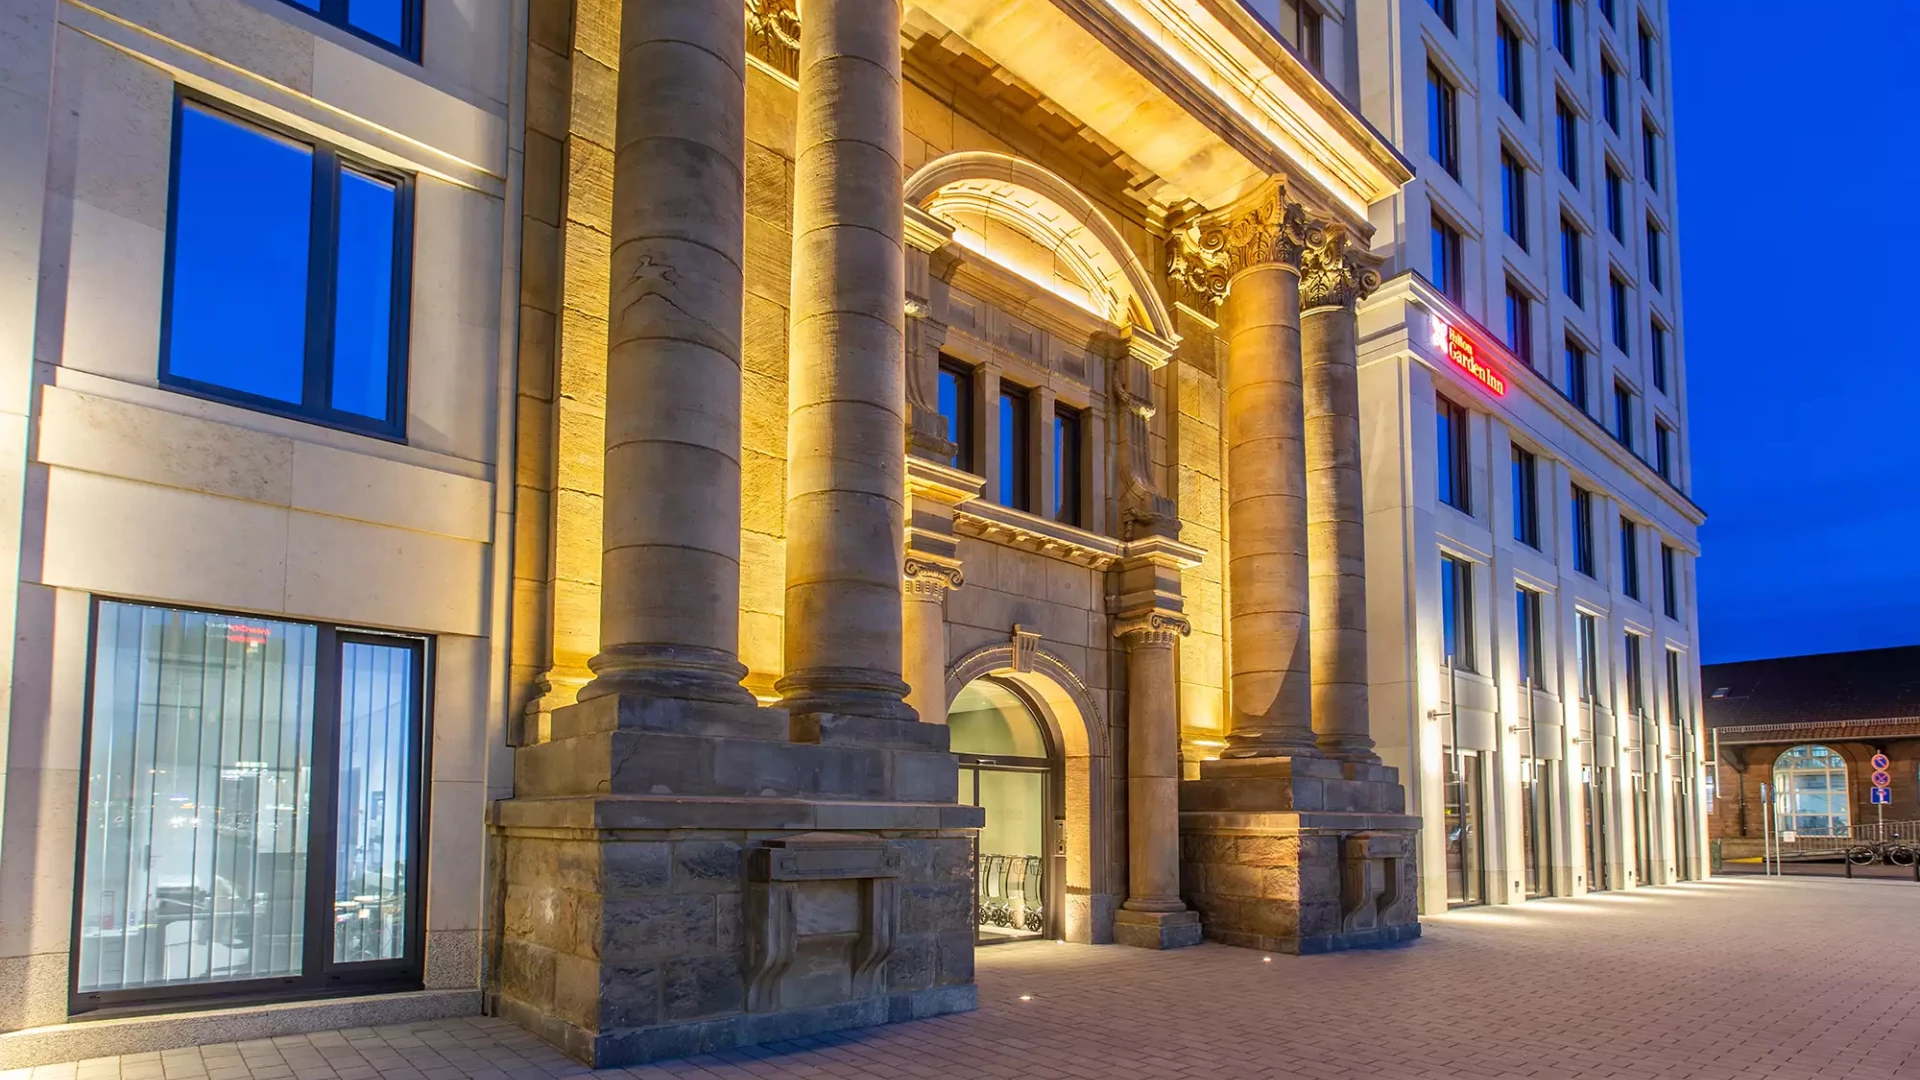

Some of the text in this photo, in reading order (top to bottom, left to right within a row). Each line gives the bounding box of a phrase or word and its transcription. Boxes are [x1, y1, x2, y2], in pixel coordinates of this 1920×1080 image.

[1449, 327, 1473, 355] Hilton
[1449, 341, 1504, 395] Garden Inn
